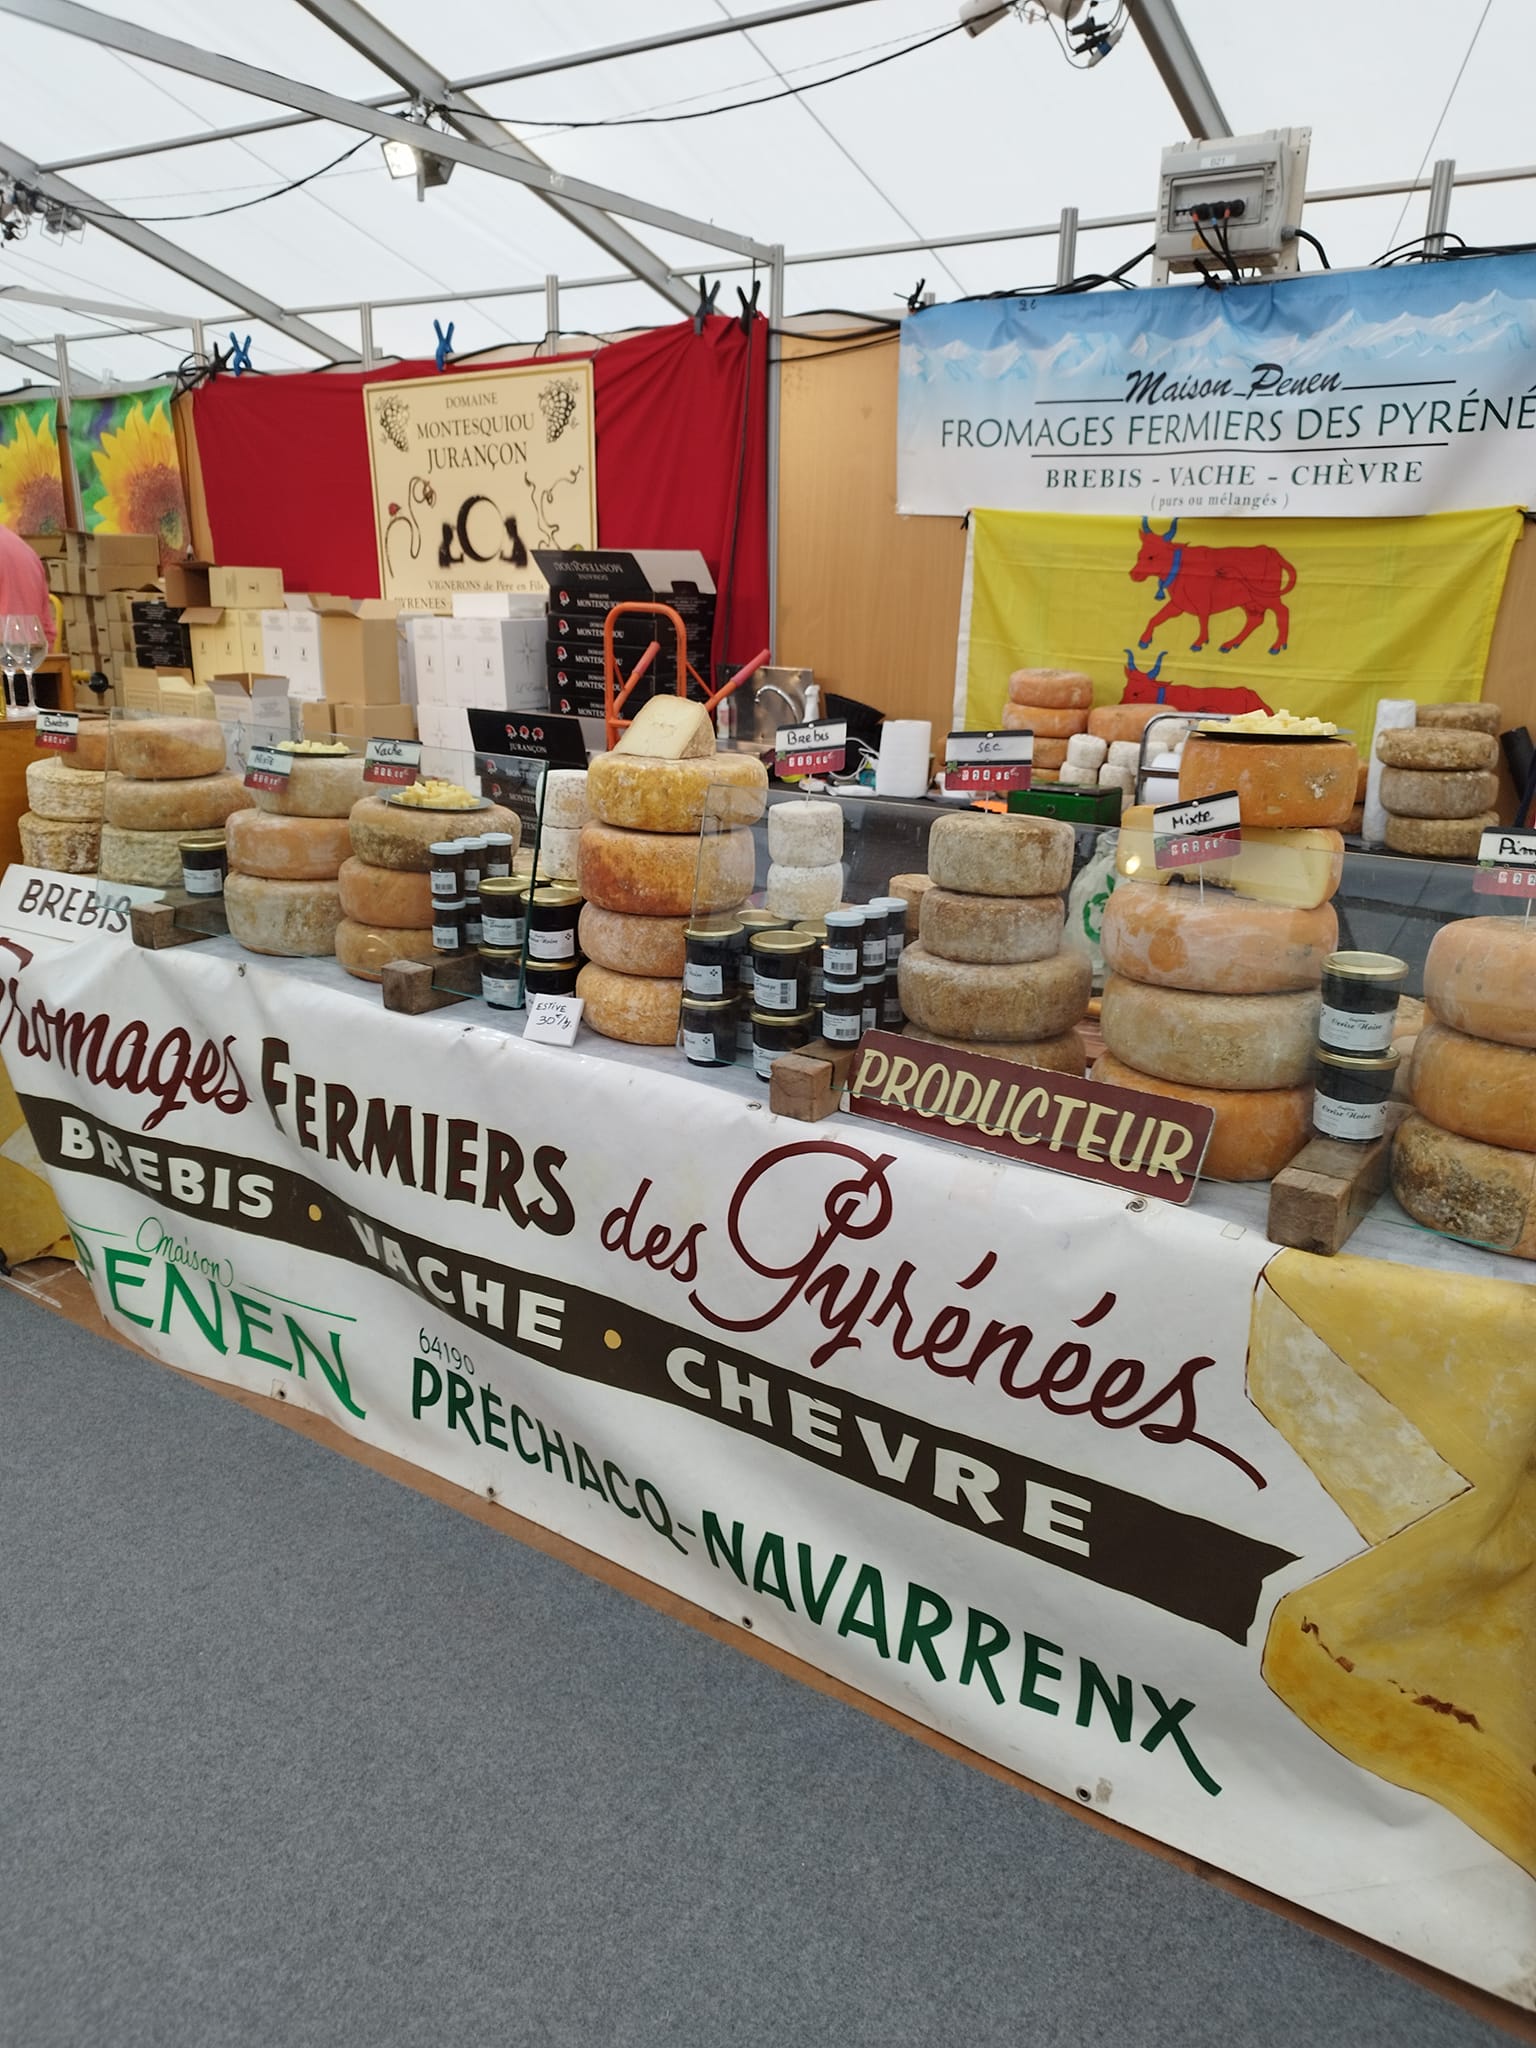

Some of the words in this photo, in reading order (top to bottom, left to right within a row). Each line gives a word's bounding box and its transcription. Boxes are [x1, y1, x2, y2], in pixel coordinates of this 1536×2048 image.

[445, 392, 498, 410] DOMAINE
[1125, 370, 1233, 405] Maison
[1246, 363, 1341, 400] Penen
[416, 413, 535, 440] MONTESQUIOU
[942, 416, 1115, 447] FROMAGES
[1128, 410, 1283, 445] FERMIERS
[1297, 405, 1363, 440] DES
[427, 442, 528, 474] JURANÇON
[1046, 468, 1142, 488] BREBIS
[1170, 464, 1256, 486] VACHE
[1291, 458, 1423, 486] CHÈVRE
[1188, 497, 1203, 506] ou
[428, 580, 481, 591] VIGNERONS
[484, 580, 493, 591] de
[516, 582, 527, 591] en
[529, 580, 545, 592] Fils
[1172, 810, 1215, 829] Mixte
[18, 879, 131, 934] BREBIS
[853, 1048, 1194, 1185] PRODUCTEUR
[262, 1037, 576, 1237] FERMIERS
[601, 1178, 706, 1282] des
[688, 1139, 1267, 1490] Pyrénées
[59, 1116, 275, 1219] BREBIS
[347, 1214, 567, 1350] VACHE
[666, 1346, 1093, 1557] CHEVRE
[419, 1327, 475, 1376] 64190
